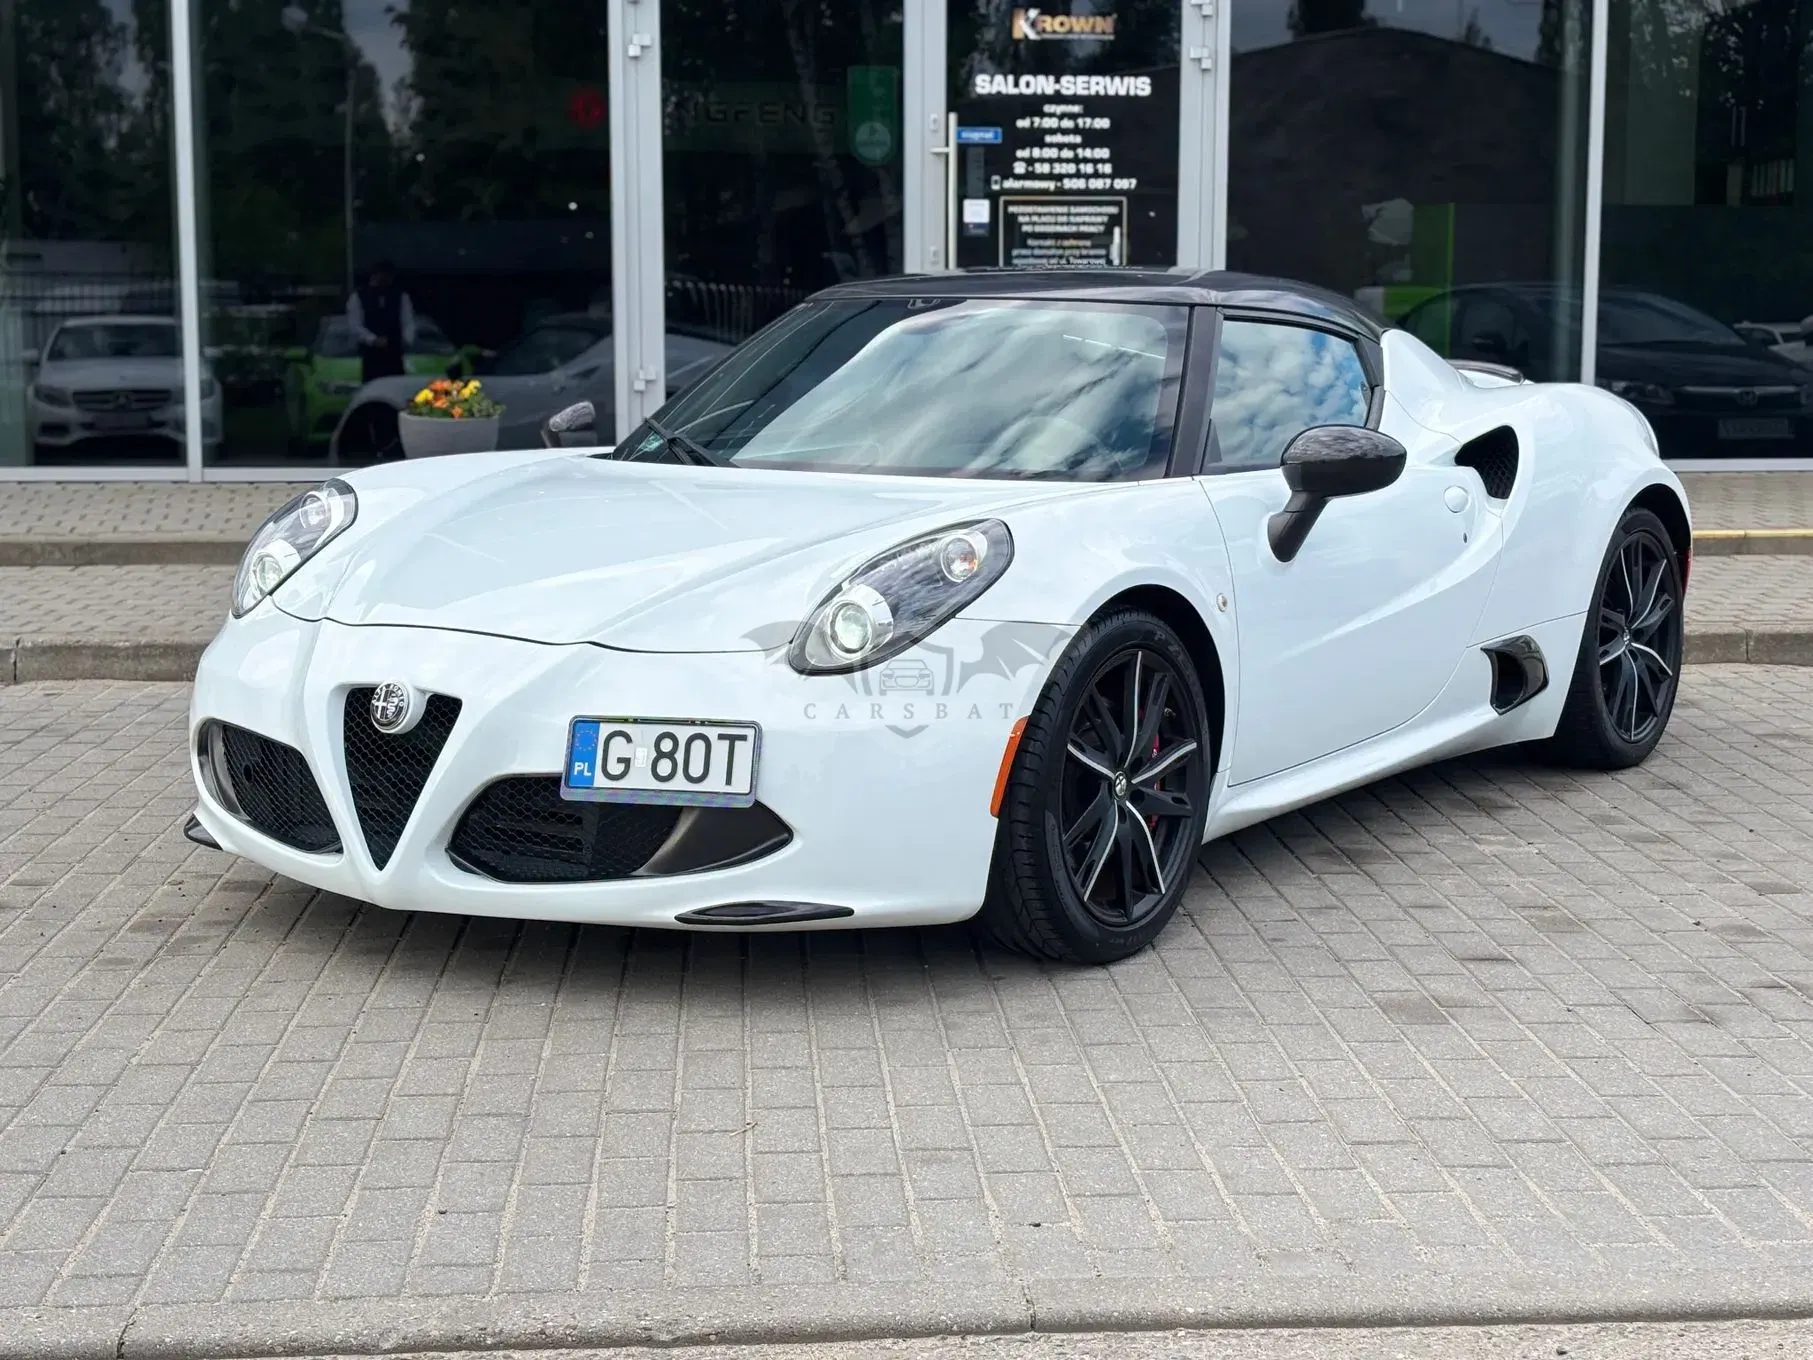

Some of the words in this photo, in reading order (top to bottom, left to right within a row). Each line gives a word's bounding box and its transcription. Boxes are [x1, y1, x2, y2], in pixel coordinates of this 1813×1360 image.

[1012, 8, 1115, 40] KROWN
[975, 74, 1152, 97] SALON-SERWIS
[1015, 117, 1031, 129] od
[1060, 118, 1075, 129] do
[1015, 147, 1031, 159] od
[1060, 148, 1075, 159] do
[573, 762, 592, 776] PL
[601, 730, 633, 781] G
